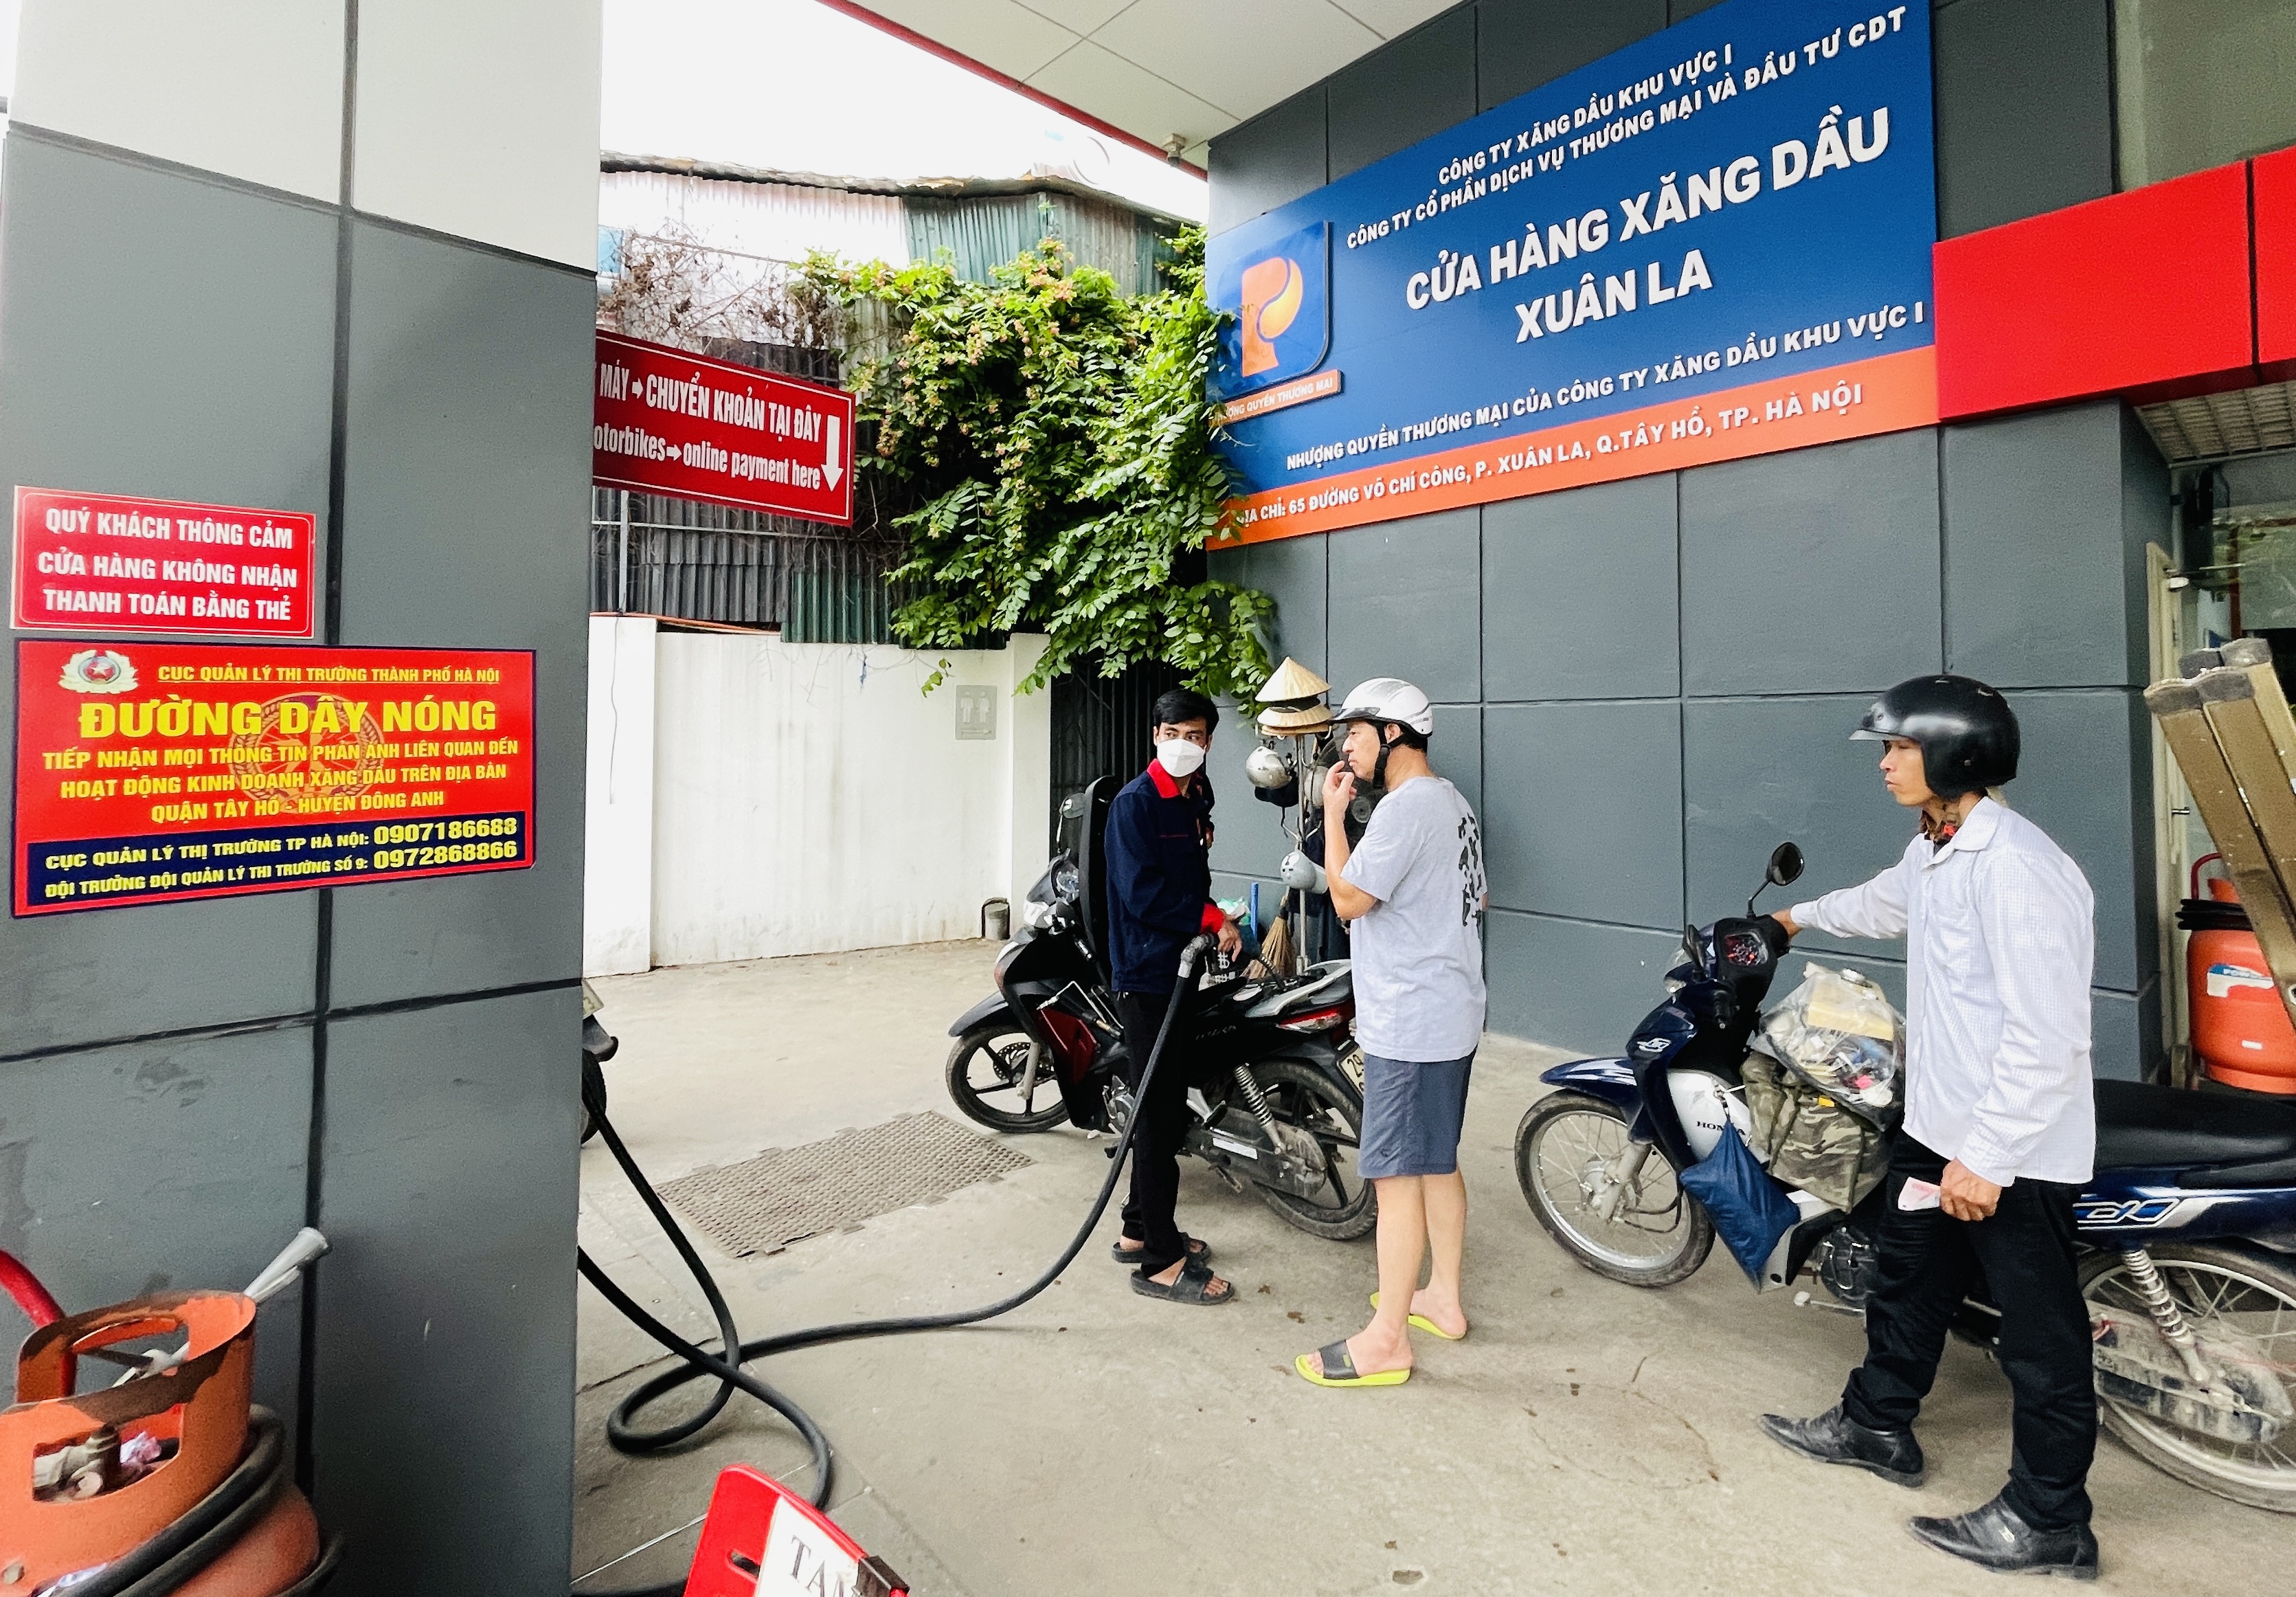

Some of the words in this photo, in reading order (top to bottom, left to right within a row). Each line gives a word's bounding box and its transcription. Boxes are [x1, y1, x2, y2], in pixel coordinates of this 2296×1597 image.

[1347, 219, 1389, 249] CÔNG
[1391, 208, 1413, 232] TY
[1415, 188, 1439, 222] CỔ
[1440, 175, 1487, 213] PHẦN
[1489, 158, 1534, 192] DỊCH
[1536, 146, 1565, 171] VỤ
[1570, 109, 1656, 160] THƯƠNG
[1660, 89, 1702, 121] MẠI
[1707, 71, 1737, 104] VÀ
[1744, 50, 1797, 91] ĐẦU
[1803, 26, 1843, 67] TƯ
[1848, 5, 1907, 49] CDT
[1439, 150, 1487, 186] CÔNG
[1489, 138, 1513, 164] TY
[1517, 113, 1571, 153] XĂNG
[1573, 93, 1615, 130] DẦU
[1617, 73, 1664, 109] KHU
[1669, 50, 1718, 87] VỰC
[1724, 43, 1732, 65] I
[1406, 249, 1482, 310] CỬA
[1489, 208, 1610, 284] HÀNG
[1619, 155, 1761, 241] XĂNG
[1772, 104, 1890, 192] DẦU
[1515, 269, 1637, 344] XUÂN
[1646, 249, 1712, 306] LA
[600, 359, 629, 401] MÁY
[646, 371, 710, 419] CHUYỂN
[713, 386, 765, 431] KHOẢN
[769, 403, 790, 442] TẠI
[794, 405, 822, 443] ĐÂY
[1247, 393, 1275, 412] QUYỀN
[1277, 383, 1314, 402] THƯƠNG
[1286, 443, 1344, 471] NHƯỢNG
[1347, 423, 1399, 454] QUYỀN
[1402, 411, 1472, 443] THƯƠNG
[1476, 403, 1509, 427] MẠI
[1513, 388, 1553, 416] CỦA
[1557, 379, 1614, 405] CÔNG
[1618, 368, 1648, 392] TY
[1654, 355, 1720, 383] XĂNG
[1726, 332, 1777, 368] DẦU
[1784, 320, 1841, 353] KHU
[1848, 304, 1906, 341] VỰC
[1914, 301, 1923, 324] I
[594, 423, 666, 461] otorbikes
[683, 440, 728, 473] online
[731, 451, 789, 482] payment
[792, 462, 820, 490] here
[1237, 508, 1258, 528] ỊA
[1261, 496, 1286, 520] CHỈ:
[1289, 497, 1305, 514] 65
[1309, 486, 1360, 512] ĐƯỜNG
[1363, 478, 1385, 500] VÕ
[1388, 471, 1417, 495] CHÍ
[1419, 465, 1472, 489] CÔNG,
[1475, 462, 1492, 478] P.
[1498, 445, 1553, 473] XUÂN
[1557, 442, 1590, 463] LA,
[1597, 421, 1665, 454] Q.TÂY
[1672, 405, 1712, 439] HỒ,
[1719, 406, 1759, 430] TP.
[1766, 392, 1803, 421] HÀ
[1812, 379, 1863, 415] NỘI
[46, 506, 91, 534] QUÝ
[98, 511, 170, 540] KHÁCH
[177, 517, 243, 546] THÔNG
[249, 520, 293, 549] CẢM
[38, 546, 85, 575] CỬA
[93, 552, 155, 579] HÀNG
[162, 558, 235, 585] KHÔNG
[241, 564, 297, 592] NHẬN
[43, 589, 121, 614] THANH
[128, 591, 185, 616] TOÁN
[192, 590, 249, 618] BẰNG
[255, 596, 291, 621] THẺ
[158, 666, 194, 683] CỤC
[200, 662, 247, 681] QUẢN
[253, 665, 271, 681] LÝ
[276, 667, 302, 684] THỊ
[306, 665, 367, 682] TRƯỜNG
[371, 666, 418, 682] THÀNH
[423, 665, 451, 682] PHỐ
[455, 667, 473, 682] HÀ
[477, 667, 499, 684] NỘI
[78, 693, 262, 738] ĐƯỜNG
[280, 695, 368, 733] DÂY
[383, 694, 496, 732] NÓNG
[43, 746, 91, 770] TIẾP
[98, 747, 157, 770] NHẬN
[164, 748, 203, 769] MỌI
[208, 745, 272, 764] THÔNG
[277, 746, 307, 762] TIN
[404, 740, 439, 758] LIÊN
[444, 741, 484, 758] QUAN
[488, 737, 518, 755] ĐẾN
[60, 779, 117, 801] HOẠT
[123, 775, 181, 798] ĐỘNG
[187, 775, 235, 792] KINH
[240, 771, 304, 790] DOANH
[310, 768, 357, 787] XĂNG
[363, 763, 396, 784] DẦU
[401, 764, 440, 783] TRÊN
[445, 766, 471, 783] ĐỊA
[475, 761, 506, 779] BÀN
[151, 801, 207, 824] QUẬN
[214, 798, 249, 818] TÂY
[298, 794, 356, 815] HUYỆN
[361, 790, 407, 810] ĐÔNG
[411, 791, 444, 807] ANH
[45, 853, 87, 871] CỤC
[92, 846, 146, 867] QUẢN
[152, 845, 175, 862] LÝ
[179, 844, 207, 860] THỊ
[212, 838, 282, 856] TRƯỜNG
[286, 838, 306, 850] TP
[311, 834, 333, 849] HÀ
[337, 831, 370, 849] NỘI:
[374, 817, 517, 845] 0907186688
[45, 880, 75, 899] ĐỘI
[150, 871, 177, 889] ĐỘI
[181, 867, 224, 886] QUẢN
[227, 865, 245, 881] LÝ
[334, 855, 352, 871] SỐ
[355, 858, 368, 869] 9:
[374, 840, 517, 869] 0972868866
